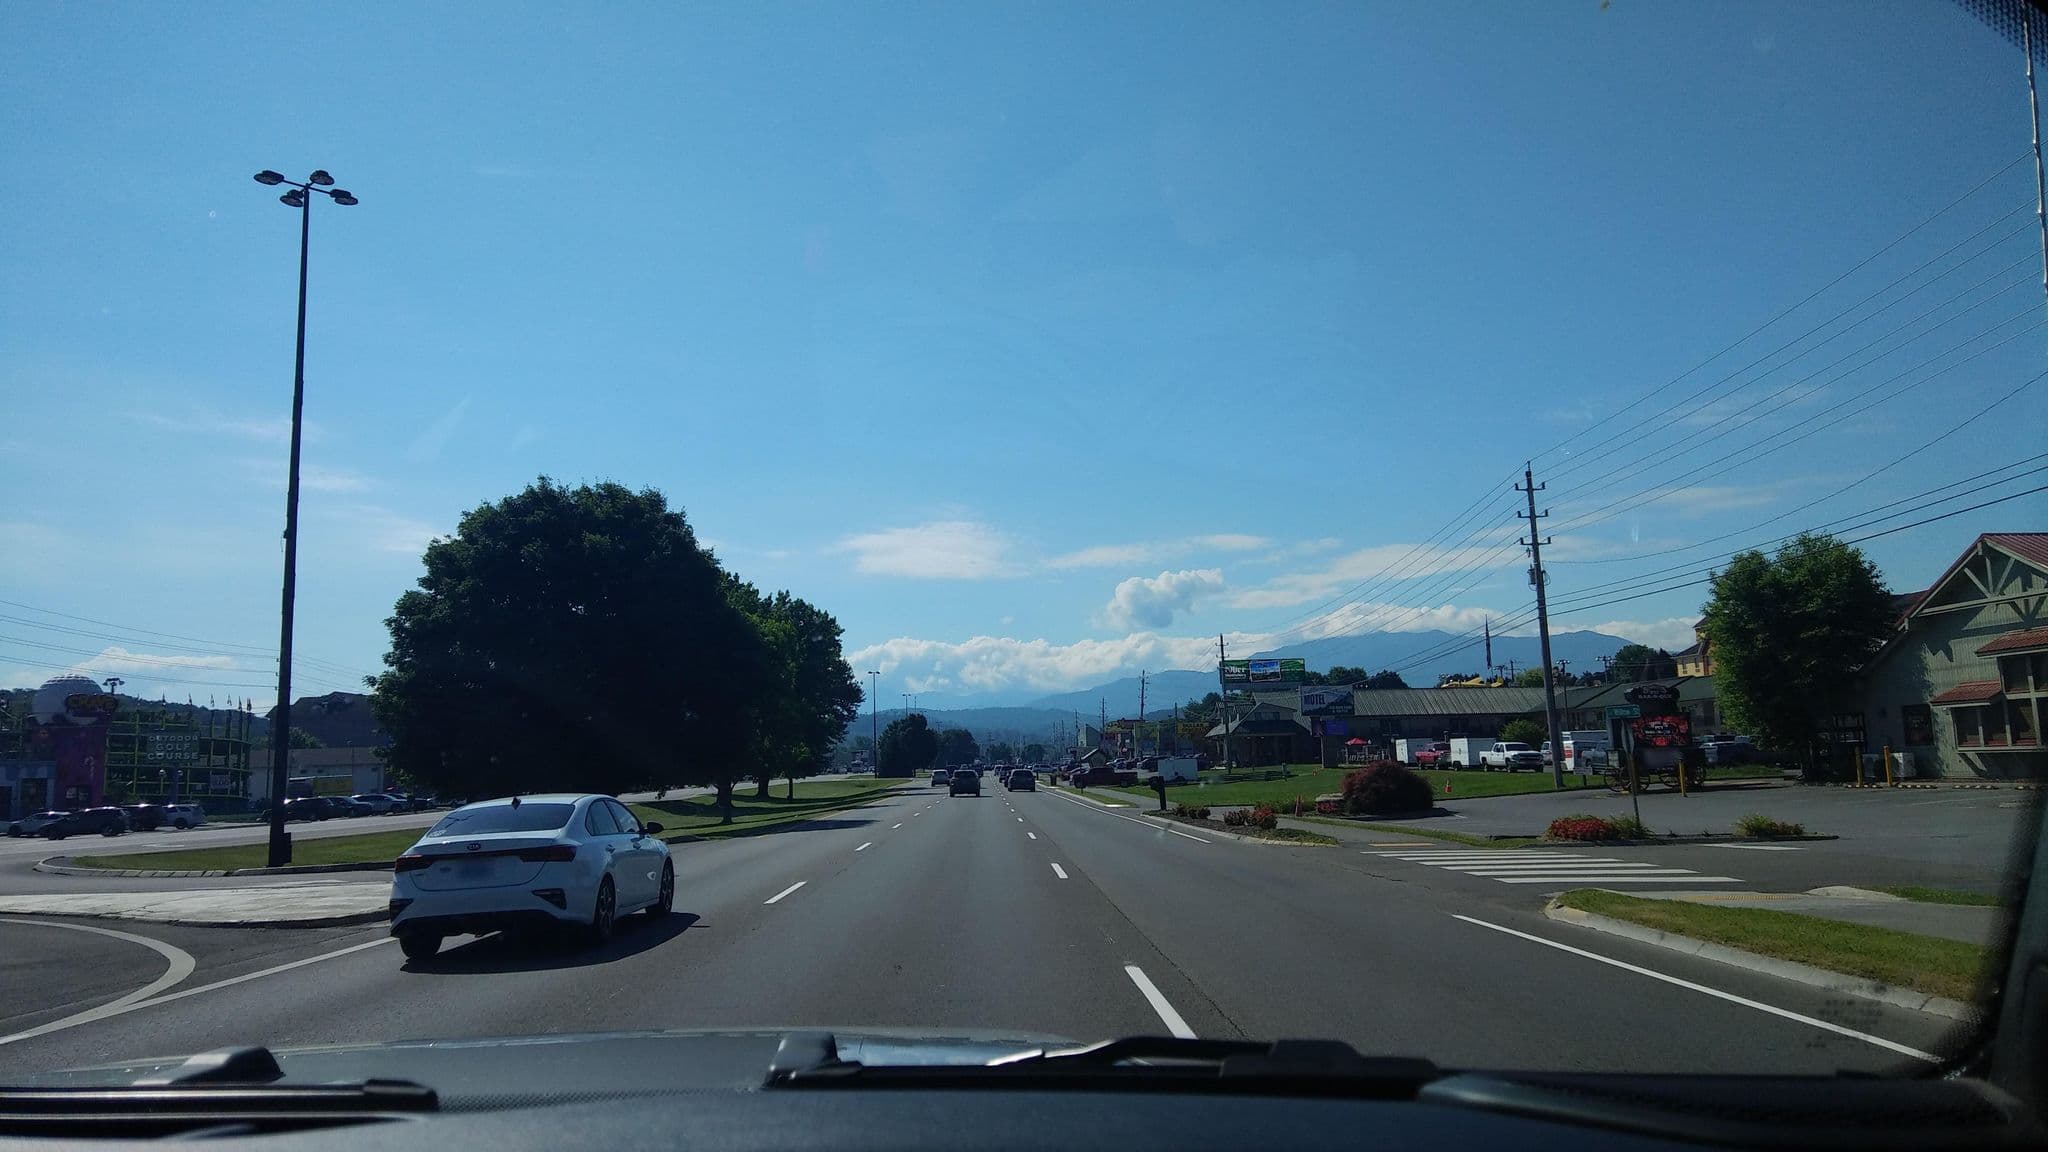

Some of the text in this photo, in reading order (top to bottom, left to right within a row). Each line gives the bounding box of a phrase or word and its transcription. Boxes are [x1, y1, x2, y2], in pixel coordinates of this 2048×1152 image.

[1303, 694, 1326, 705] MOTEL
[155, 743, 191, 751] GOLF
[147, 752, 200, 760] COURSE
